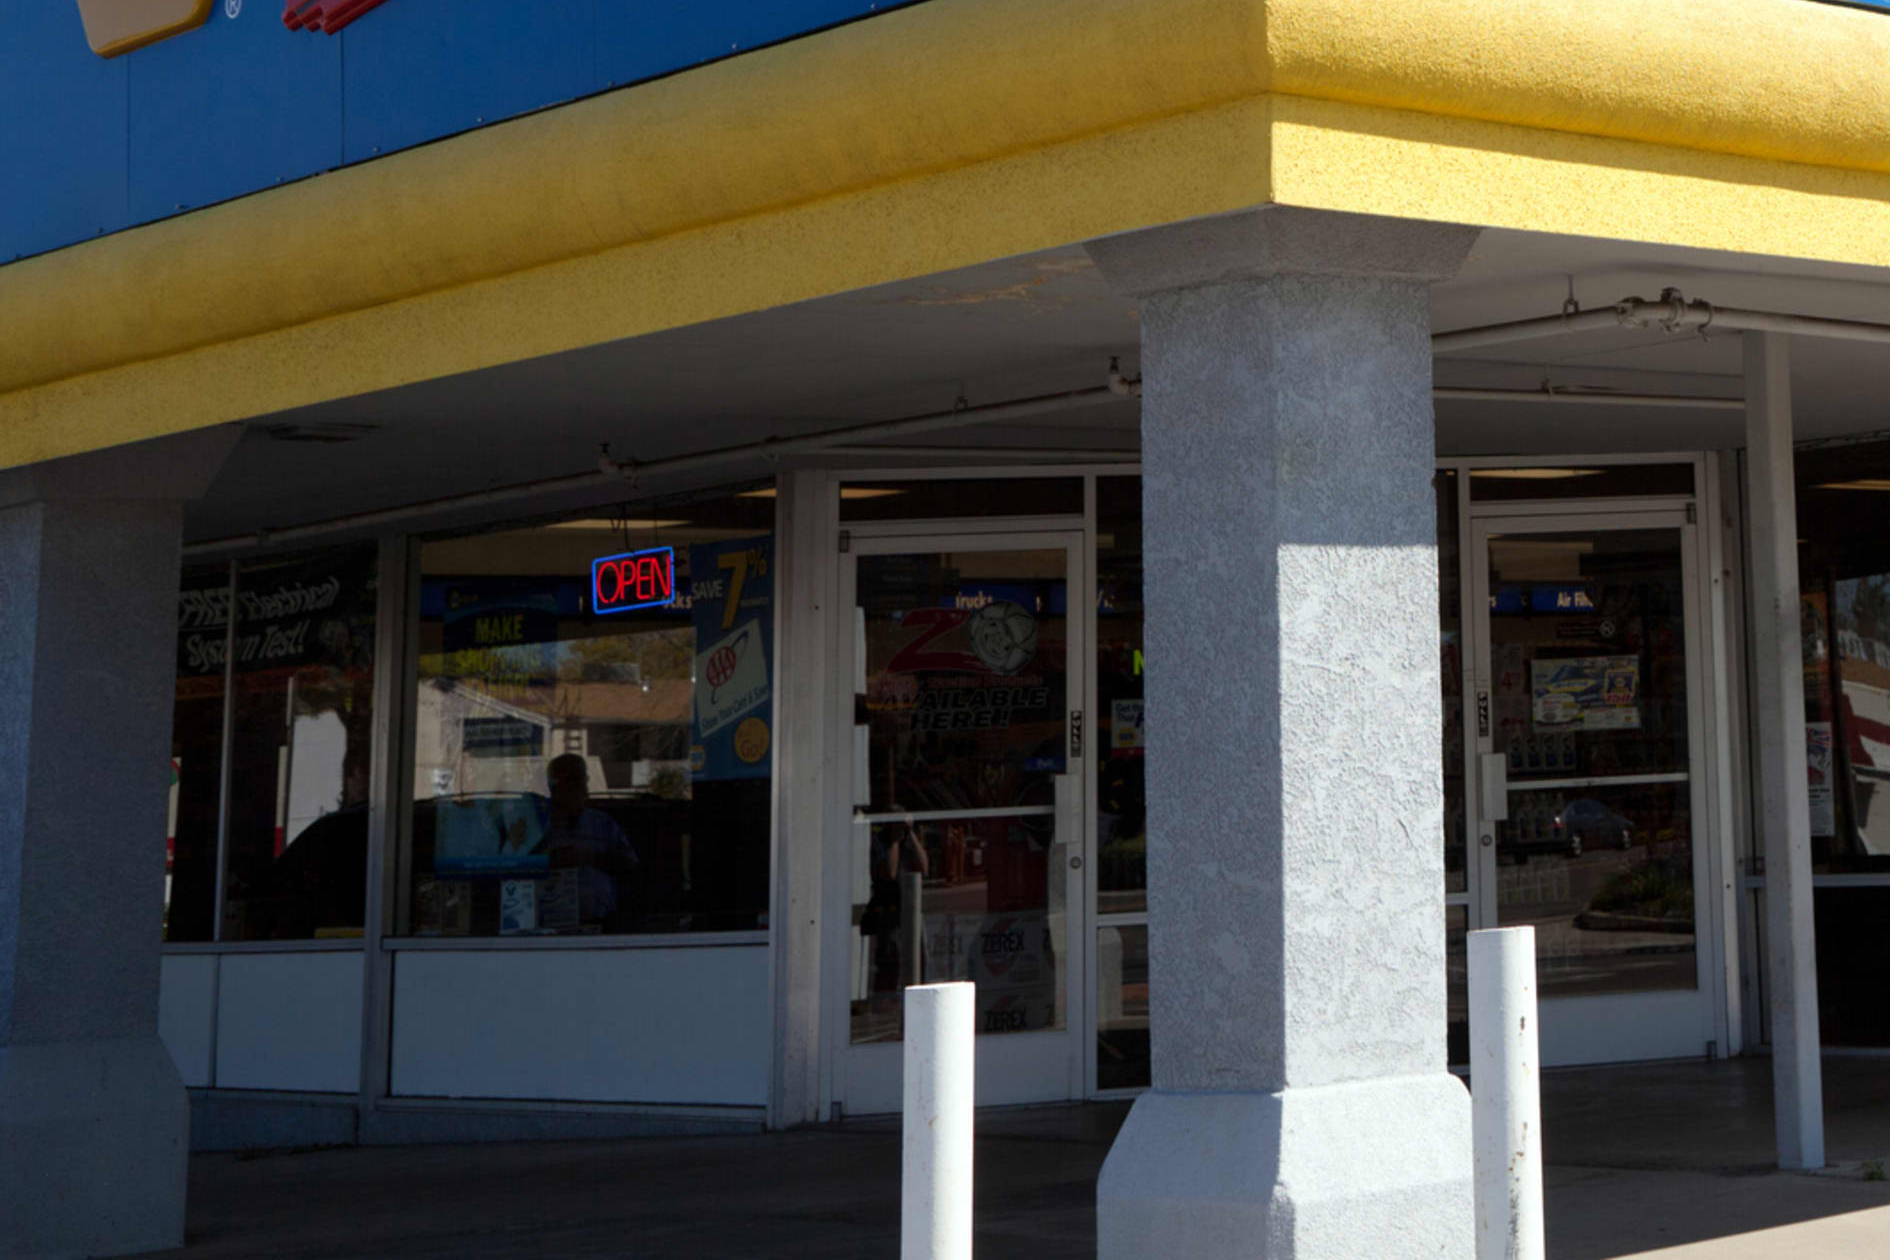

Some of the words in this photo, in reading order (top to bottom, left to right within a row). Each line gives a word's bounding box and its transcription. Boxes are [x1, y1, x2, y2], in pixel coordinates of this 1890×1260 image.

[597, 554, 672, 603] OPEN
[692, 579, 724, 602] SAVE
[474, 613, 525, 644] MAKE
[185, 634, 262, 673] Systm
[981, 930, 1025, 954] ZEREX
[984, 1009, 1027, 1032] ZEREX
